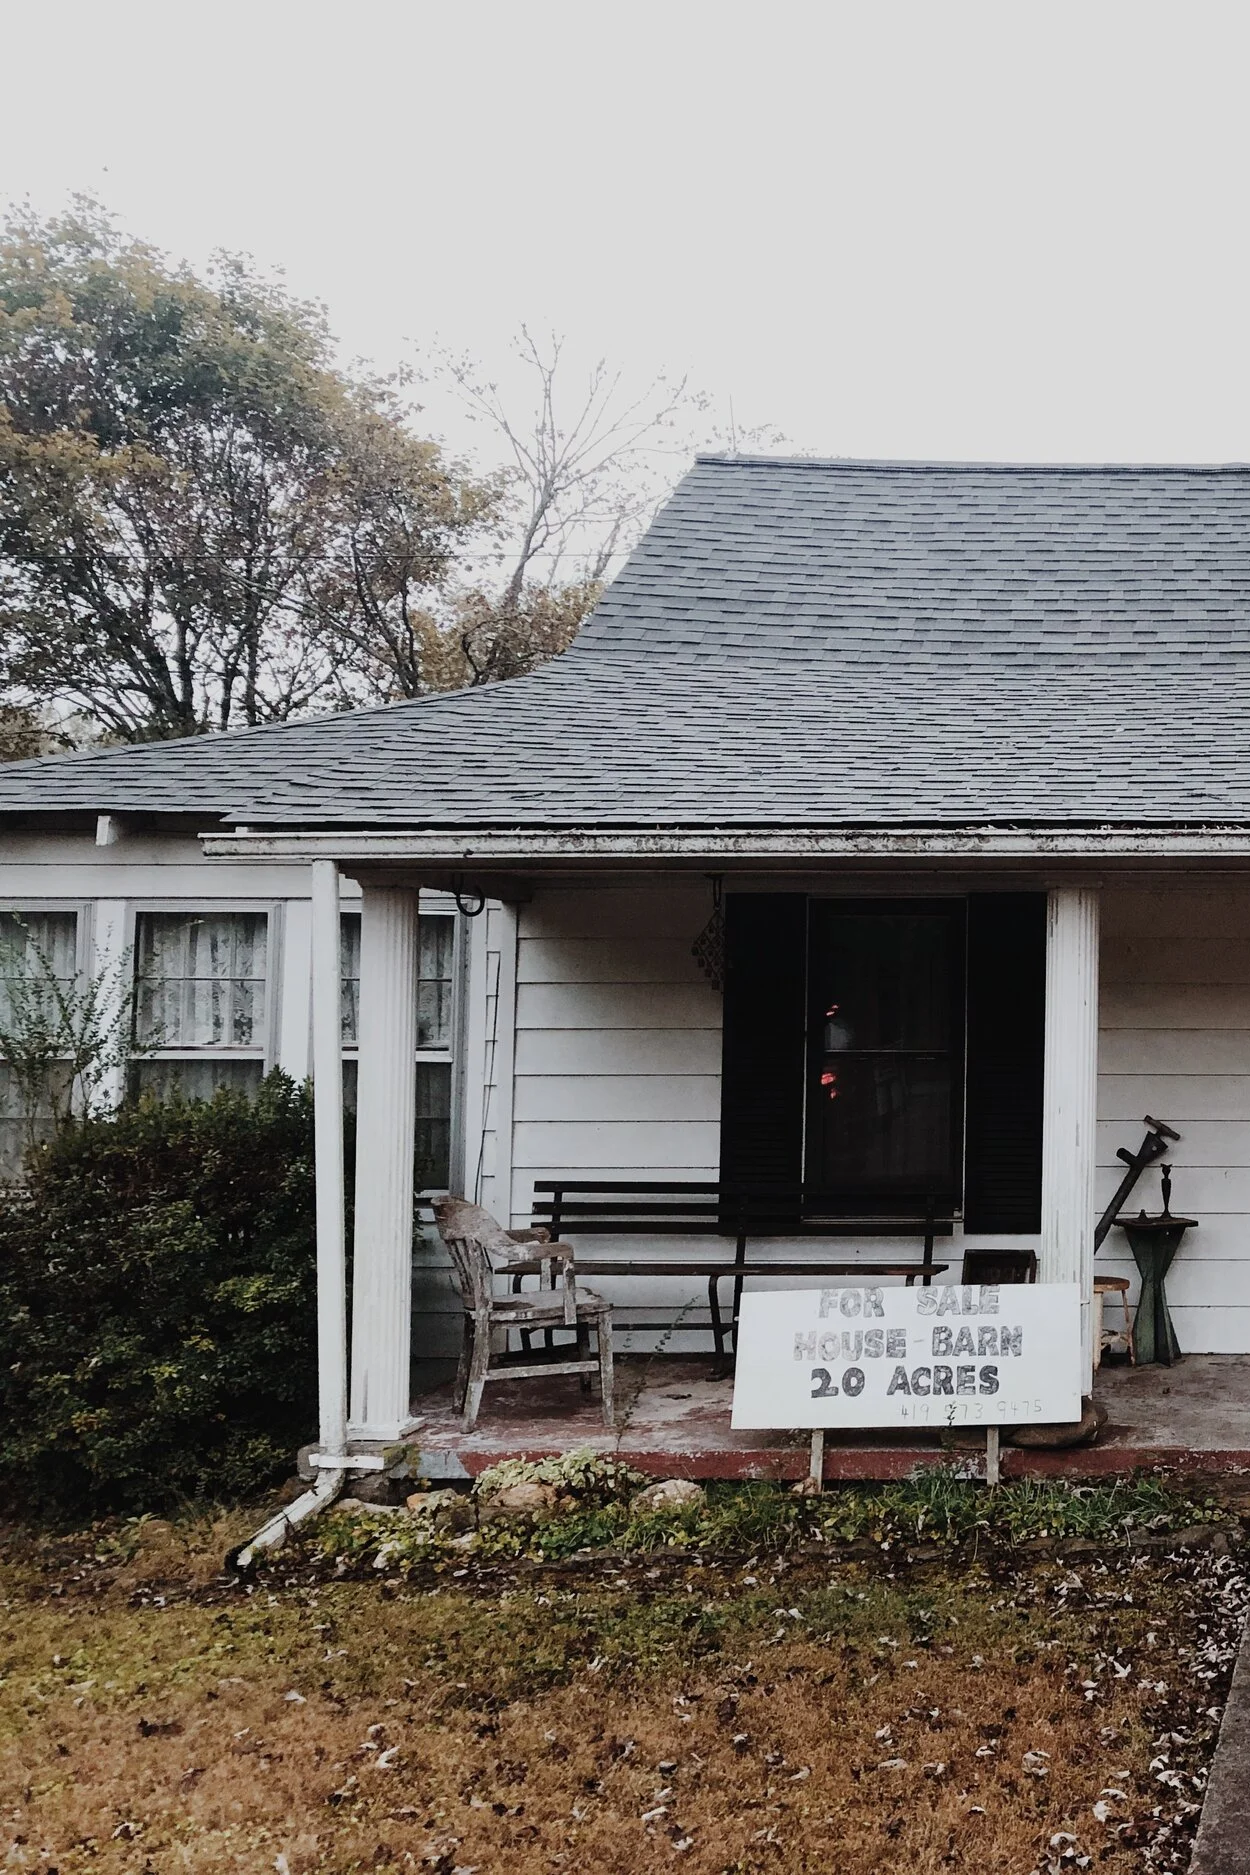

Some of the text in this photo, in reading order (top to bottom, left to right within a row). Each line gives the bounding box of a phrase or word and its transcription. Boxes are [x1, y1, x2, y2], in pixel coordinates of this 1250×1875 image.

[819, 1285, 1001, 1318] FOR SALE
[793, 1328, 907, 1361] HOUSE
[931, 1326, 1023, 1357] BARN
[810, 1365, 1000, 1398] 20 ACRES
[901, 1403, 930, 1422] 419
[996, 1399, 1043, 1420] 9475
